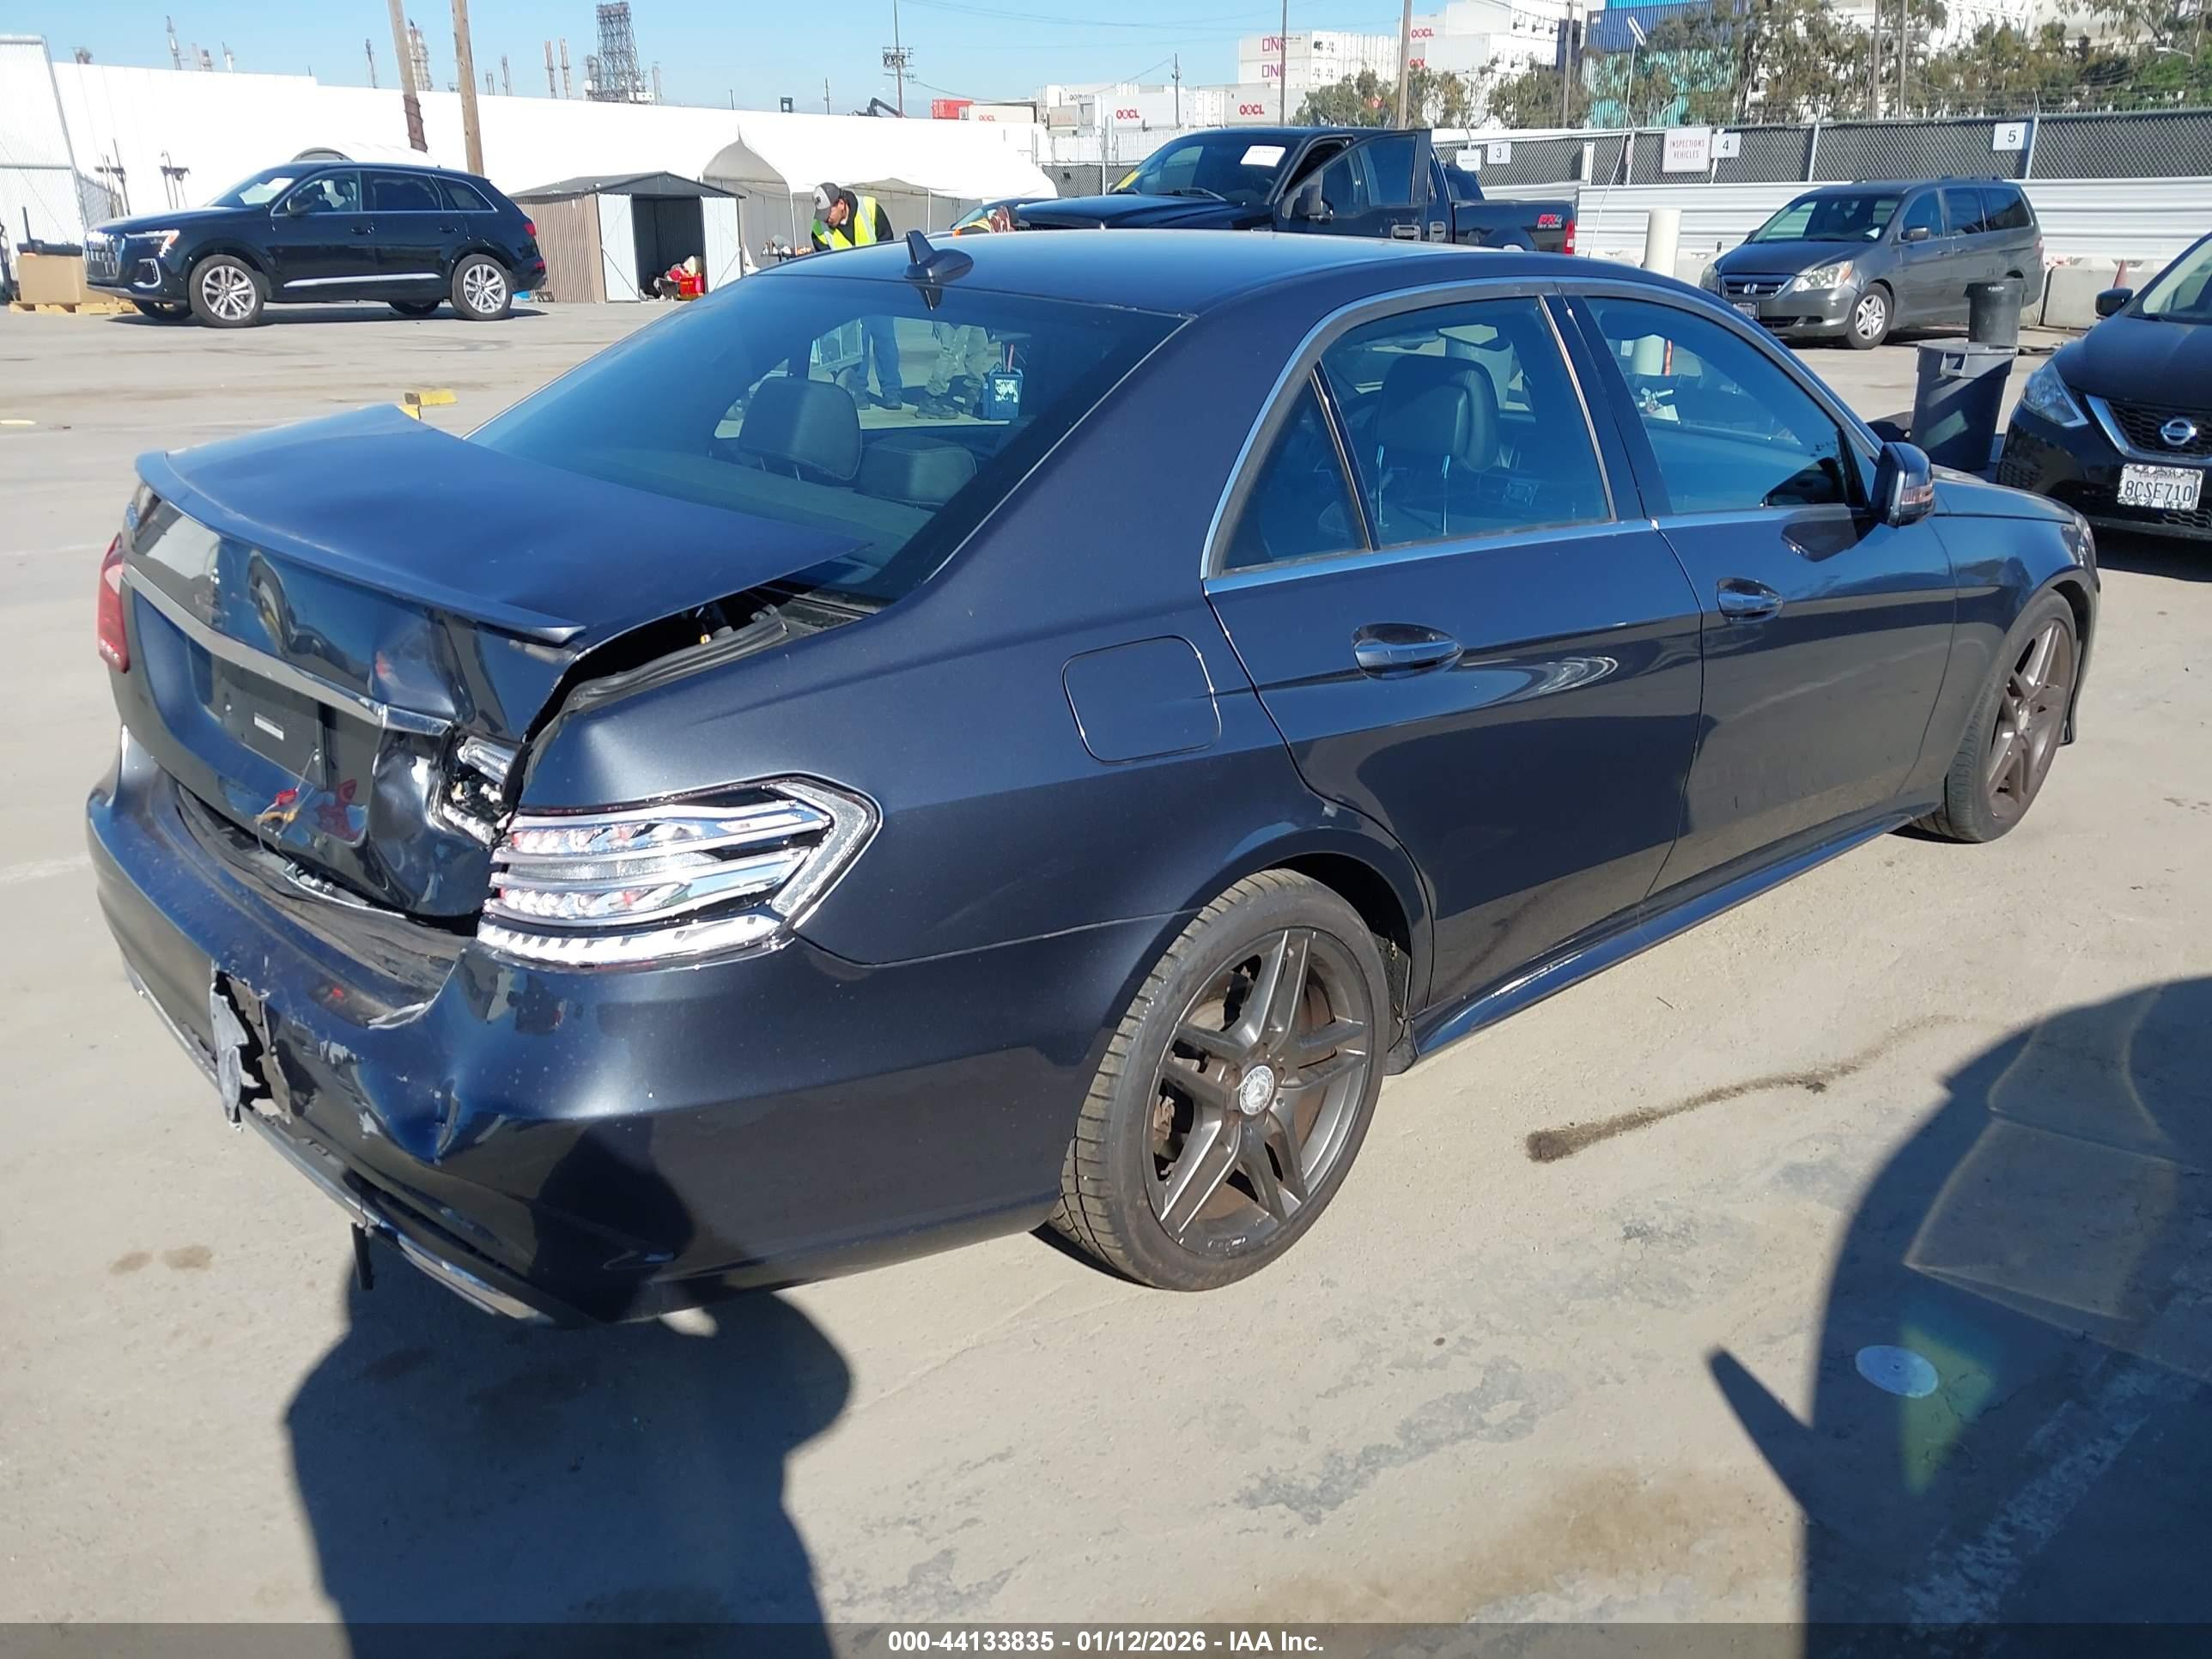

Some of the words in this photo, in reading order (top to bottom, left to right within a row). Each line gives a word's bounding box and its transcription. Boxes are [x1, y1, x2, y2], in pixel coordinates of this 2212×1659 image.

[1115, 109, 1139, 119] OOCL
[1239, 104, 1265, 115] OOCL
[2007, 130, 2017, 143] 5
[1669, 139, 1705, 149] INSPECTIONS
[1722, 139, 1729, 152] 4
[1496, 148, 1503, 159] 3
[1674, 150, 1699, 159] VEHICLES
[2124, 480, 2193, 502] 8CSE710
